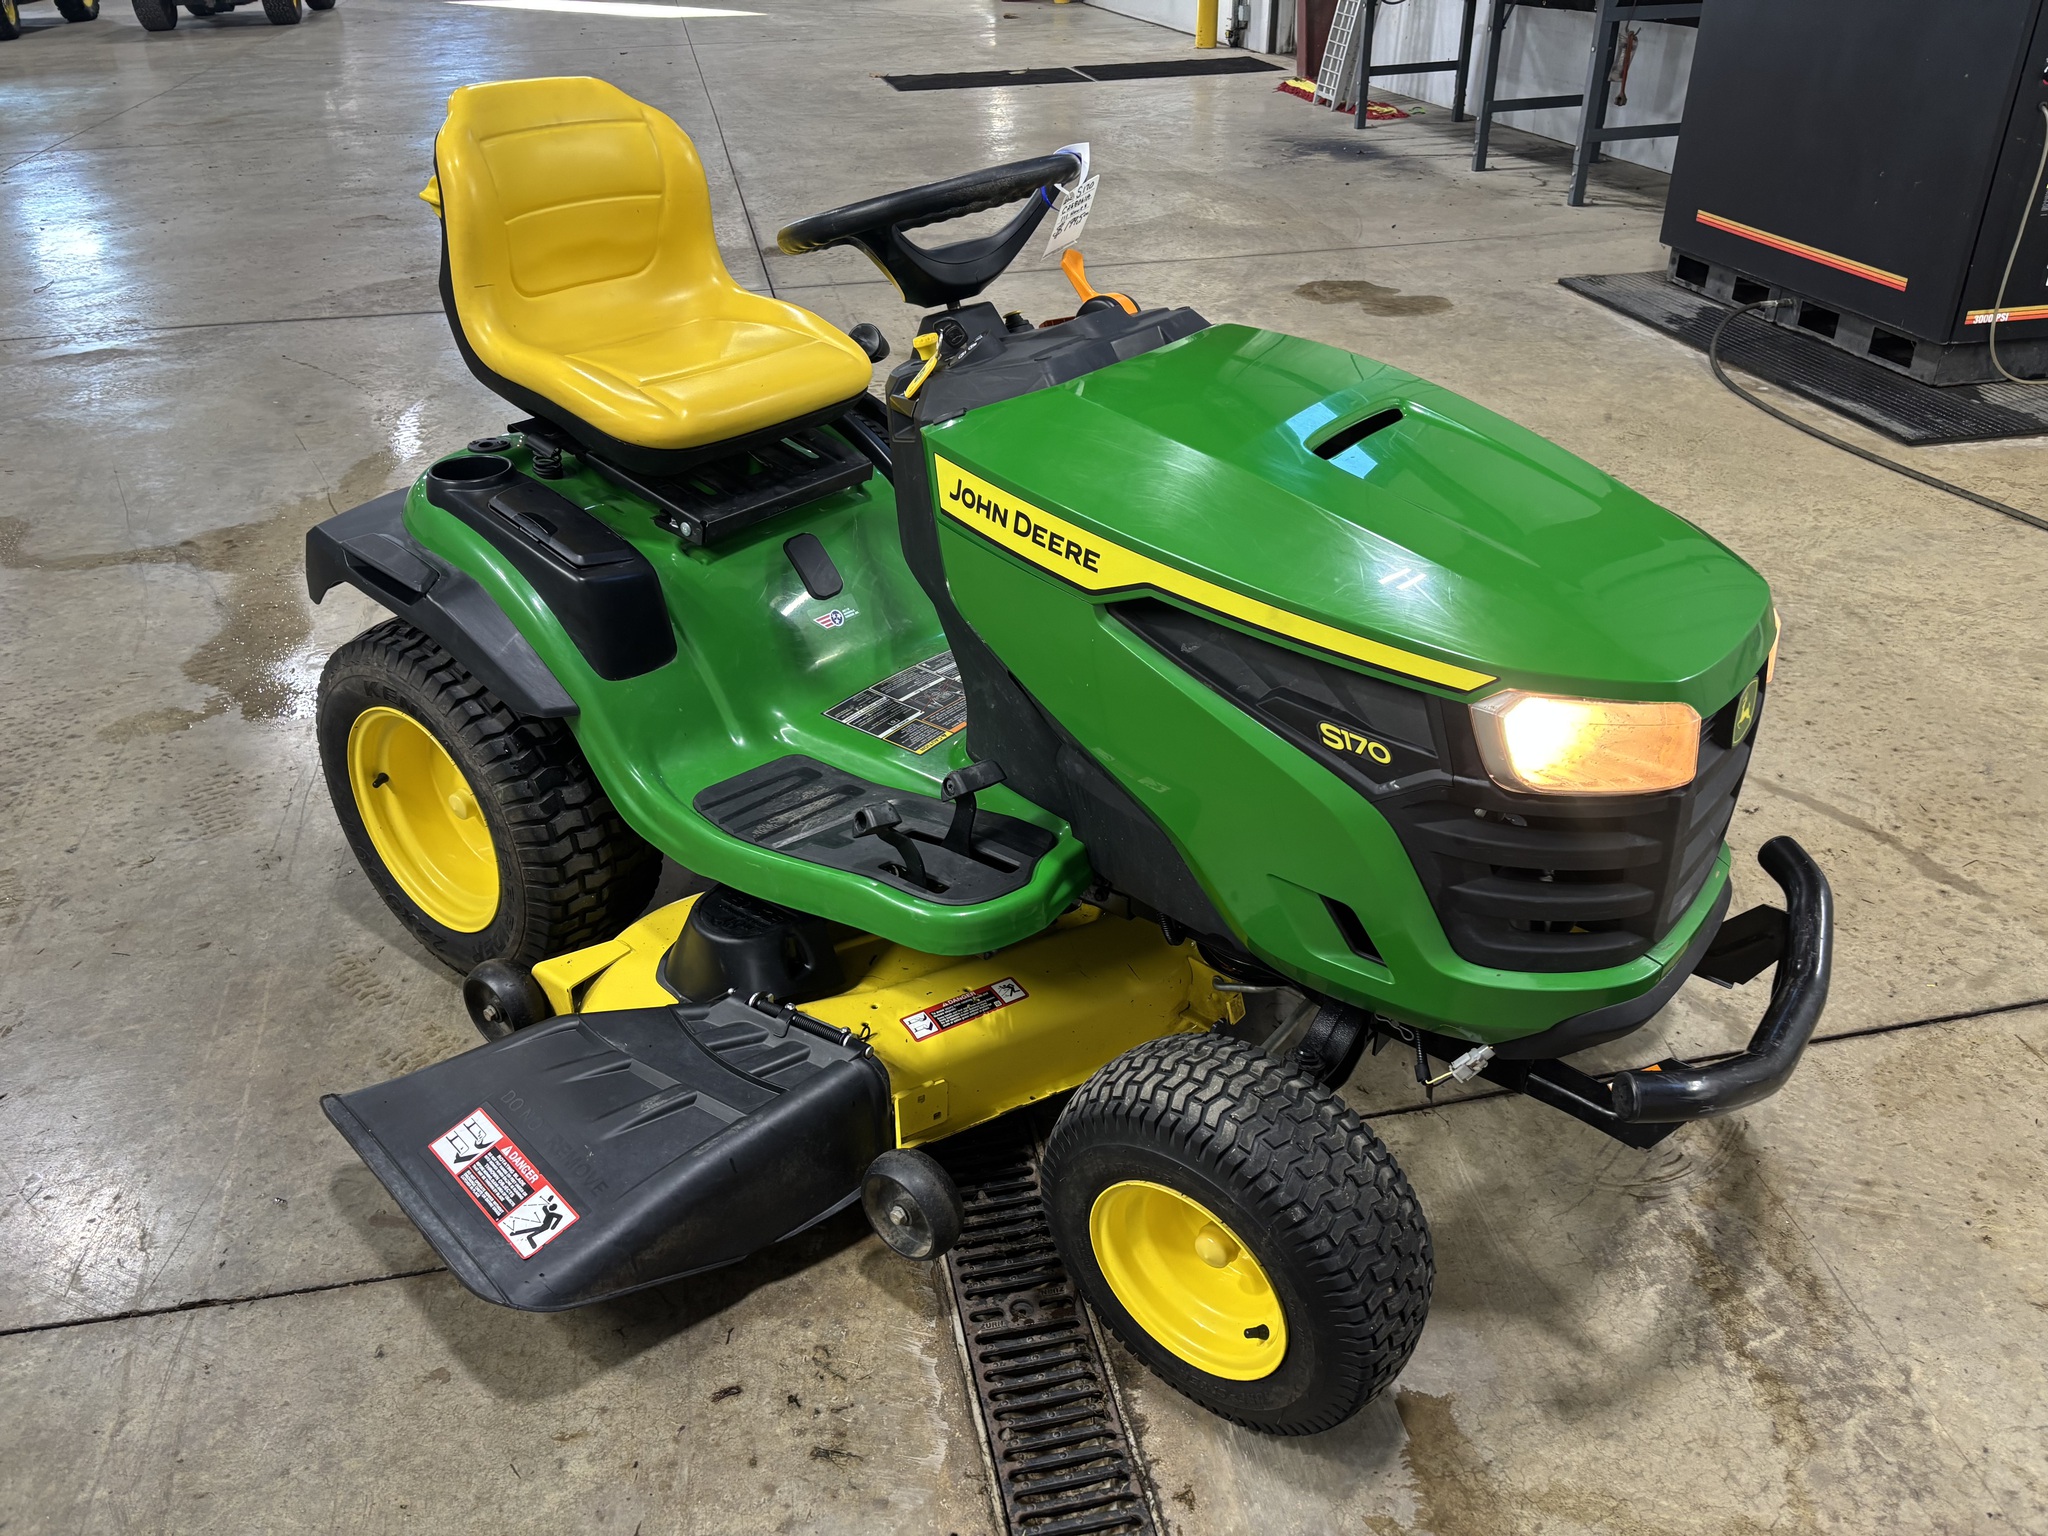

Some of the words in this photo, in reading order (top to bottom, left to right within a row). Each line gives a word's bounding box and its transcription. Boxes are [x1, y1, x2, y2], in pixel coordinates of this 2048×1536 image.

[1995, 313, 2009, 322] PSI
[949, 478, 1008, 529] JOHN
[1013, 509, 1101, 574] DEERE
[1319, 722, 1392, 765] S170
[508, 1150, 540, 1184] DANGER
